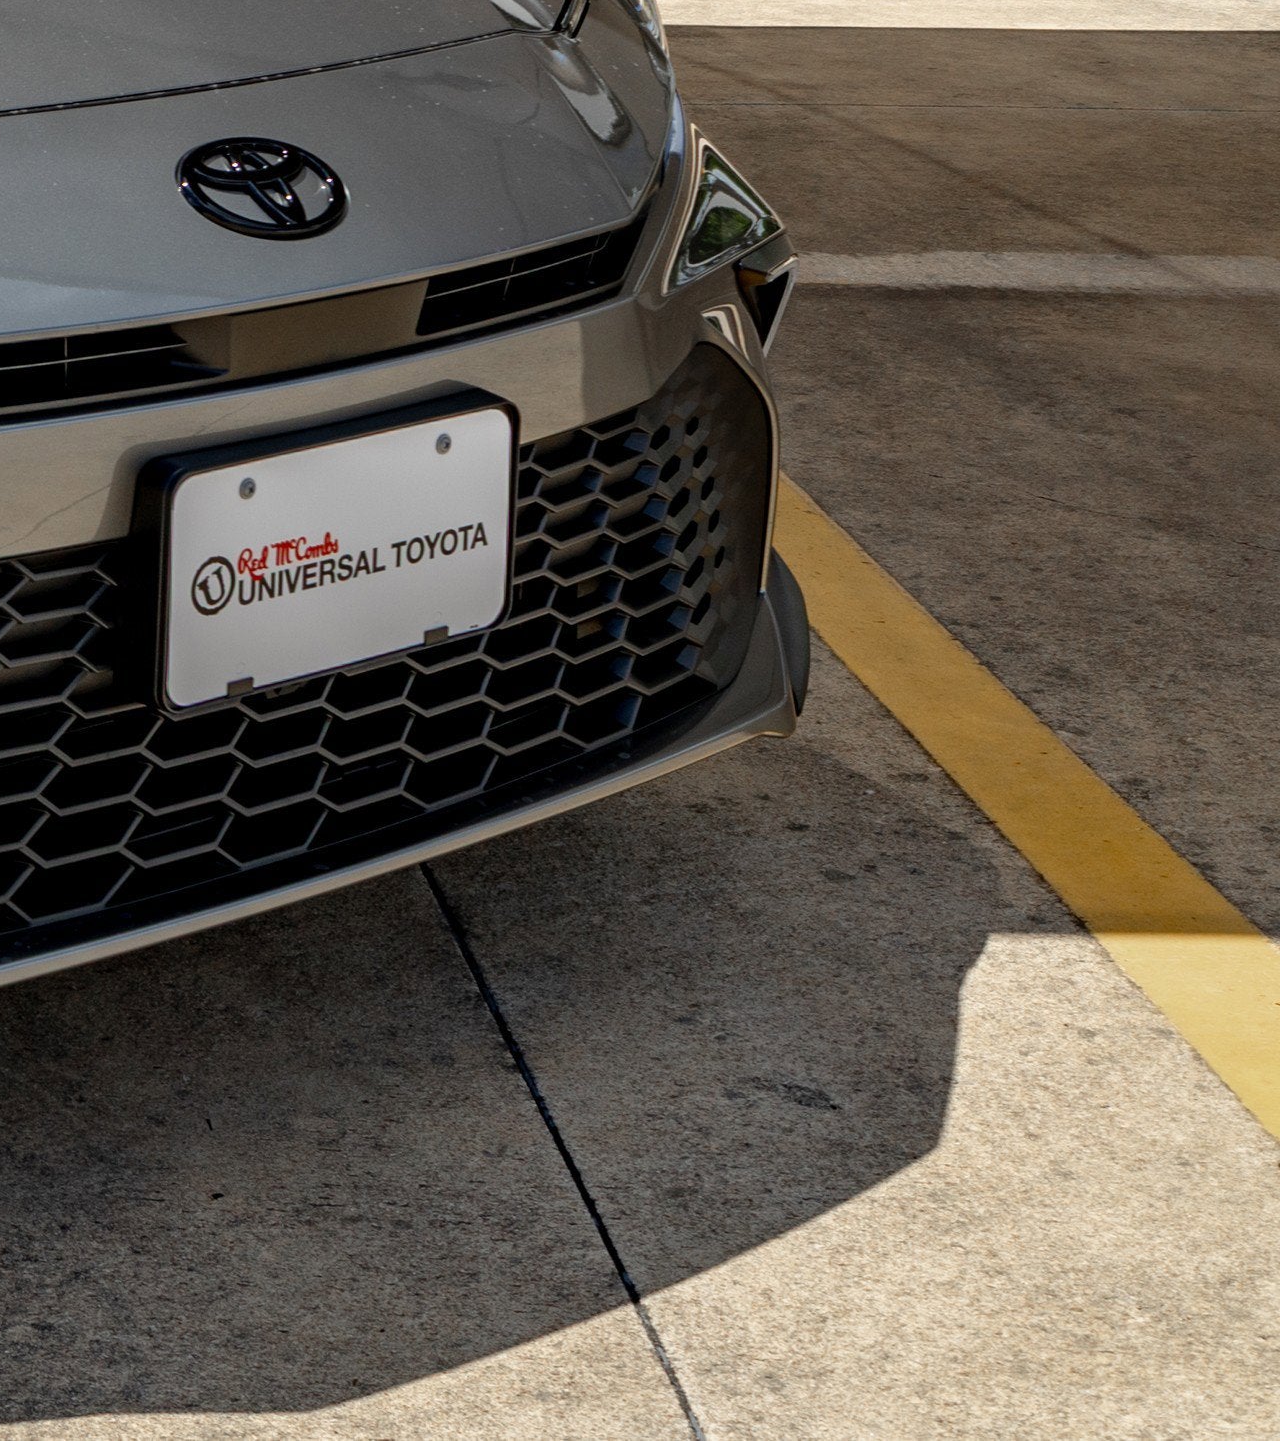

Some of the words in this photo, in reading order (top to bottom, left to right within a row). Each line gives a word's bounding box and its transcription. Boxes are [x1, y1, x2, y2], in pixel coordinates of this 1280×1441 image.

[238, 546, 269, 581] Red
[271, 531, 338, 567] McCombs
[238, 547, 386, 606] UNIVERSAL
[391, 521, 488, 568] TOYOTA
